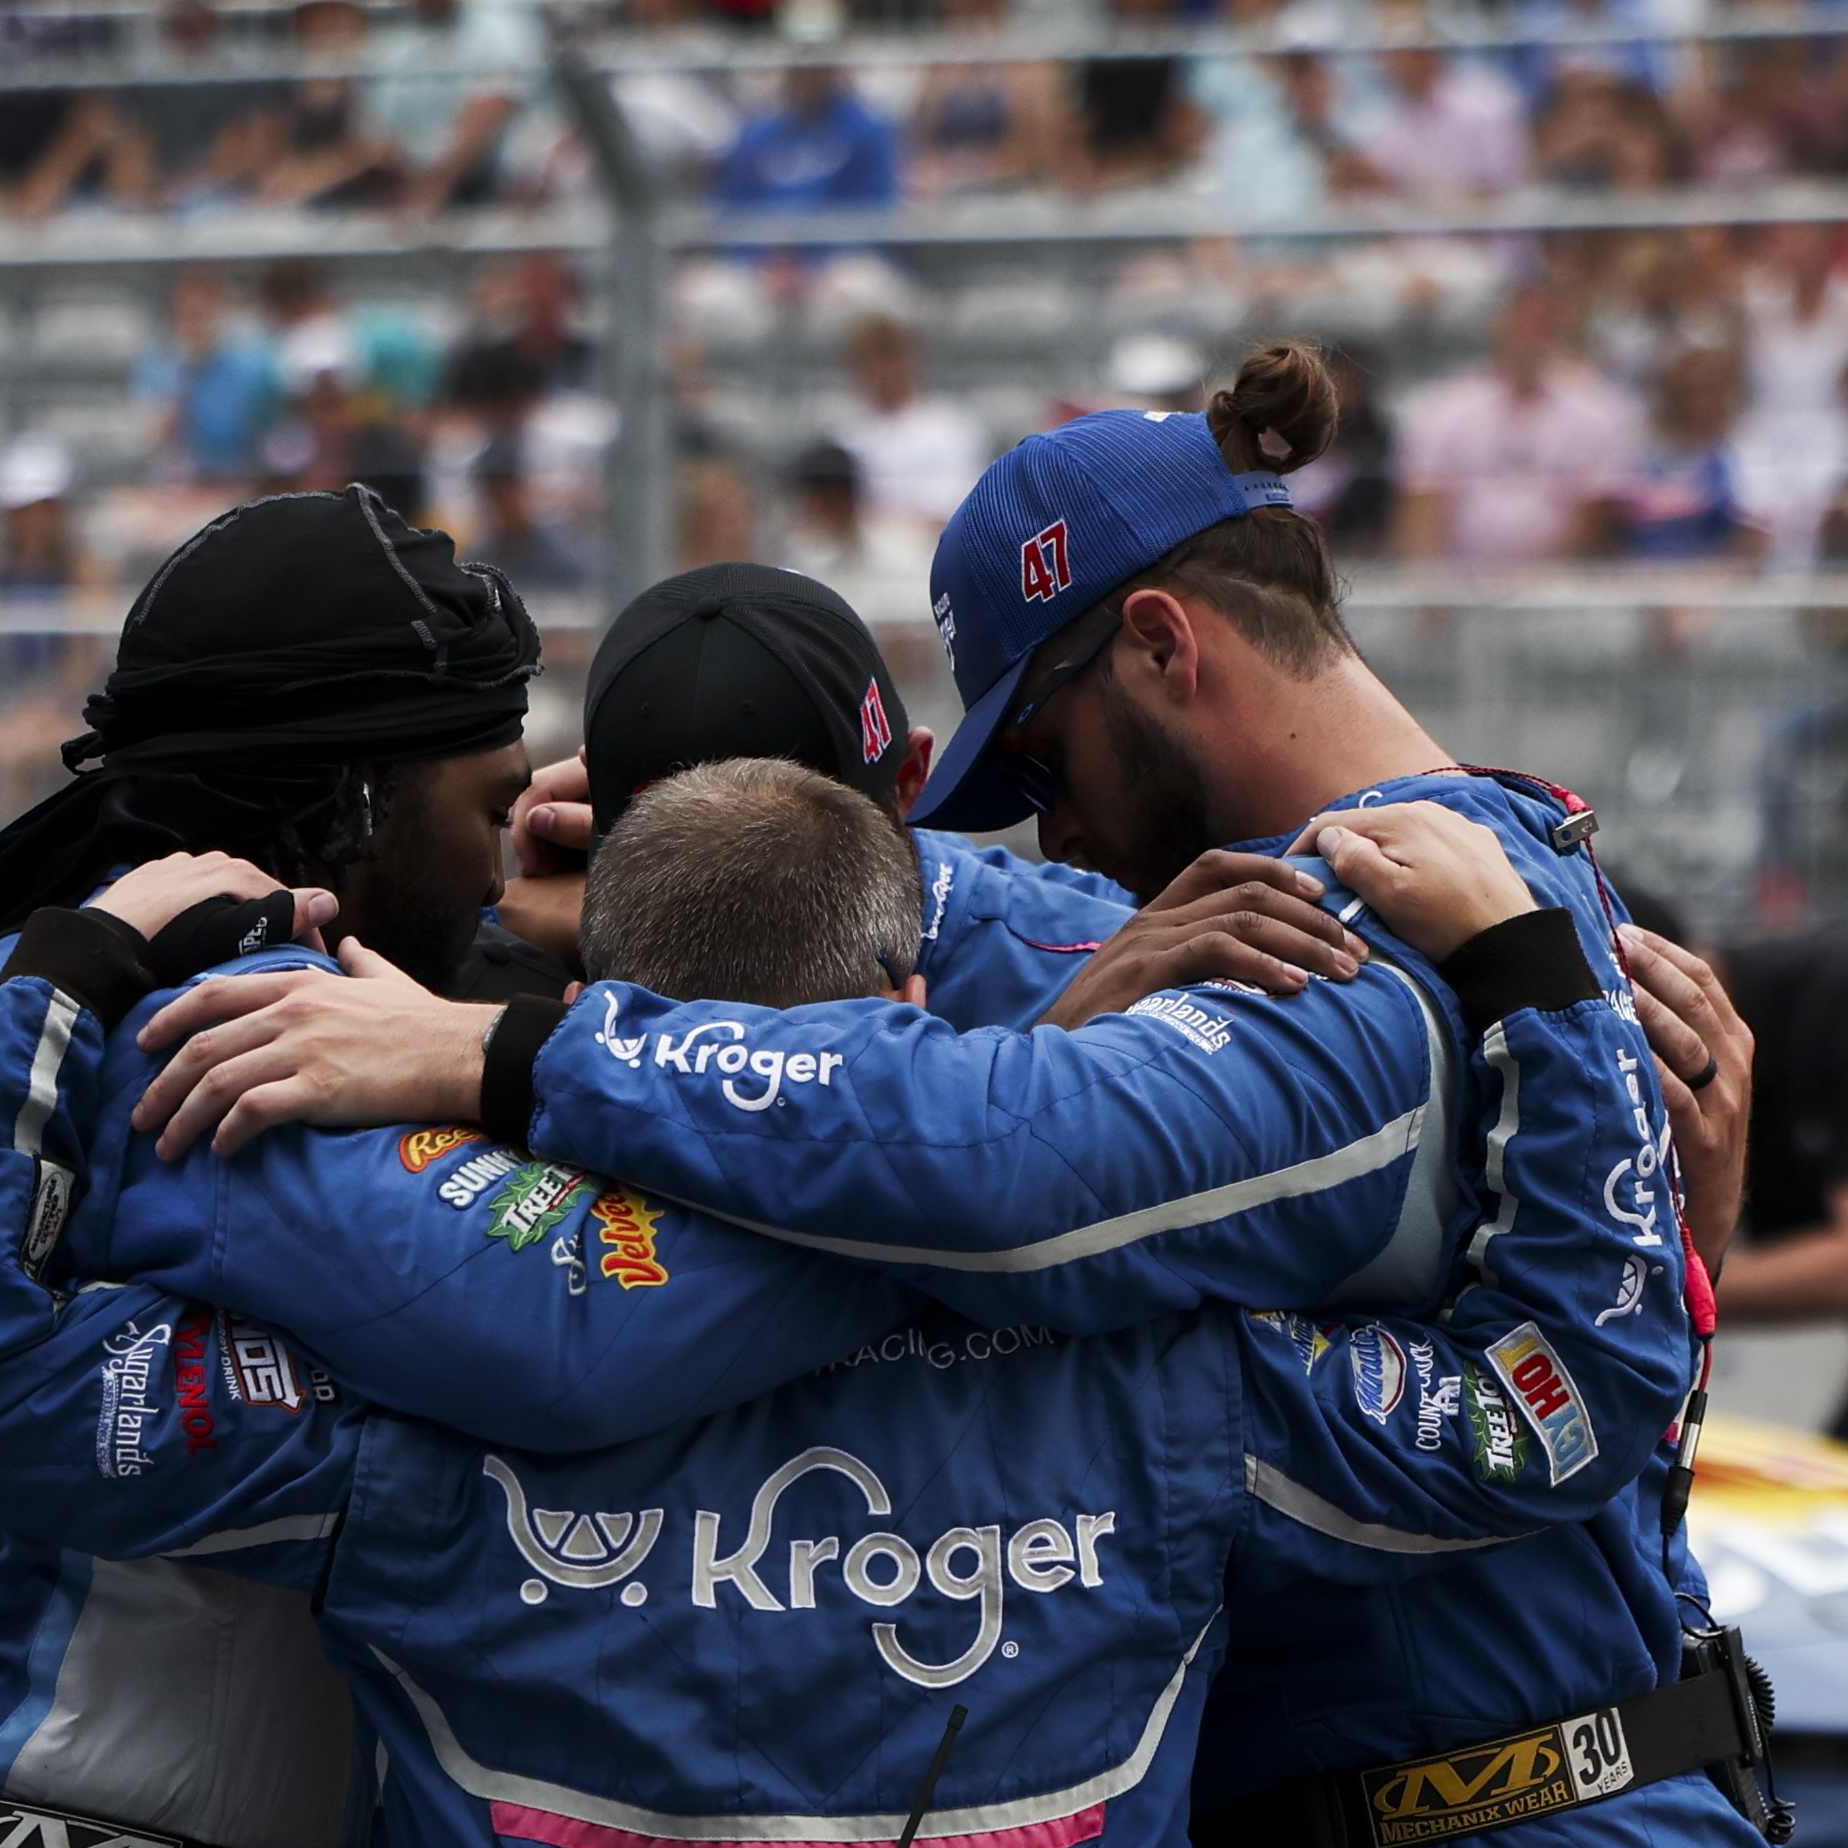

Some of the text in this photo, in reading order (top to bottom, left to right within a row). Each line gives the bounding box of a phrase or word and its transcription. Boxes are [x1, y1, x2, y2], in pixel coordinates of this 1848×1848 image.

[1021, 518, 1072, 602] 47
[860, 676, 893, 764] 47
[655, 1020, 844, 1112] Kroger
[1603, 1048, 1664, 1247] Kroger
[502, 1177, 563, 1235] TREE
[102, 1320, 173, 1478] Sugarlands
[220, 1356, 243, 1401] DRINK
[1496, 1334, 1589, 1475] ICY HOT
[1485, 1409, 1516, 1471] TREE
[692, 1446, 1117, 1691] Kroger
[1573, 1711, 1622, 1787] 30
[1596, 1761, 1629, 1794] YEARS
[1378, 1780, 1569, 1846] MECHANIX WEAR
